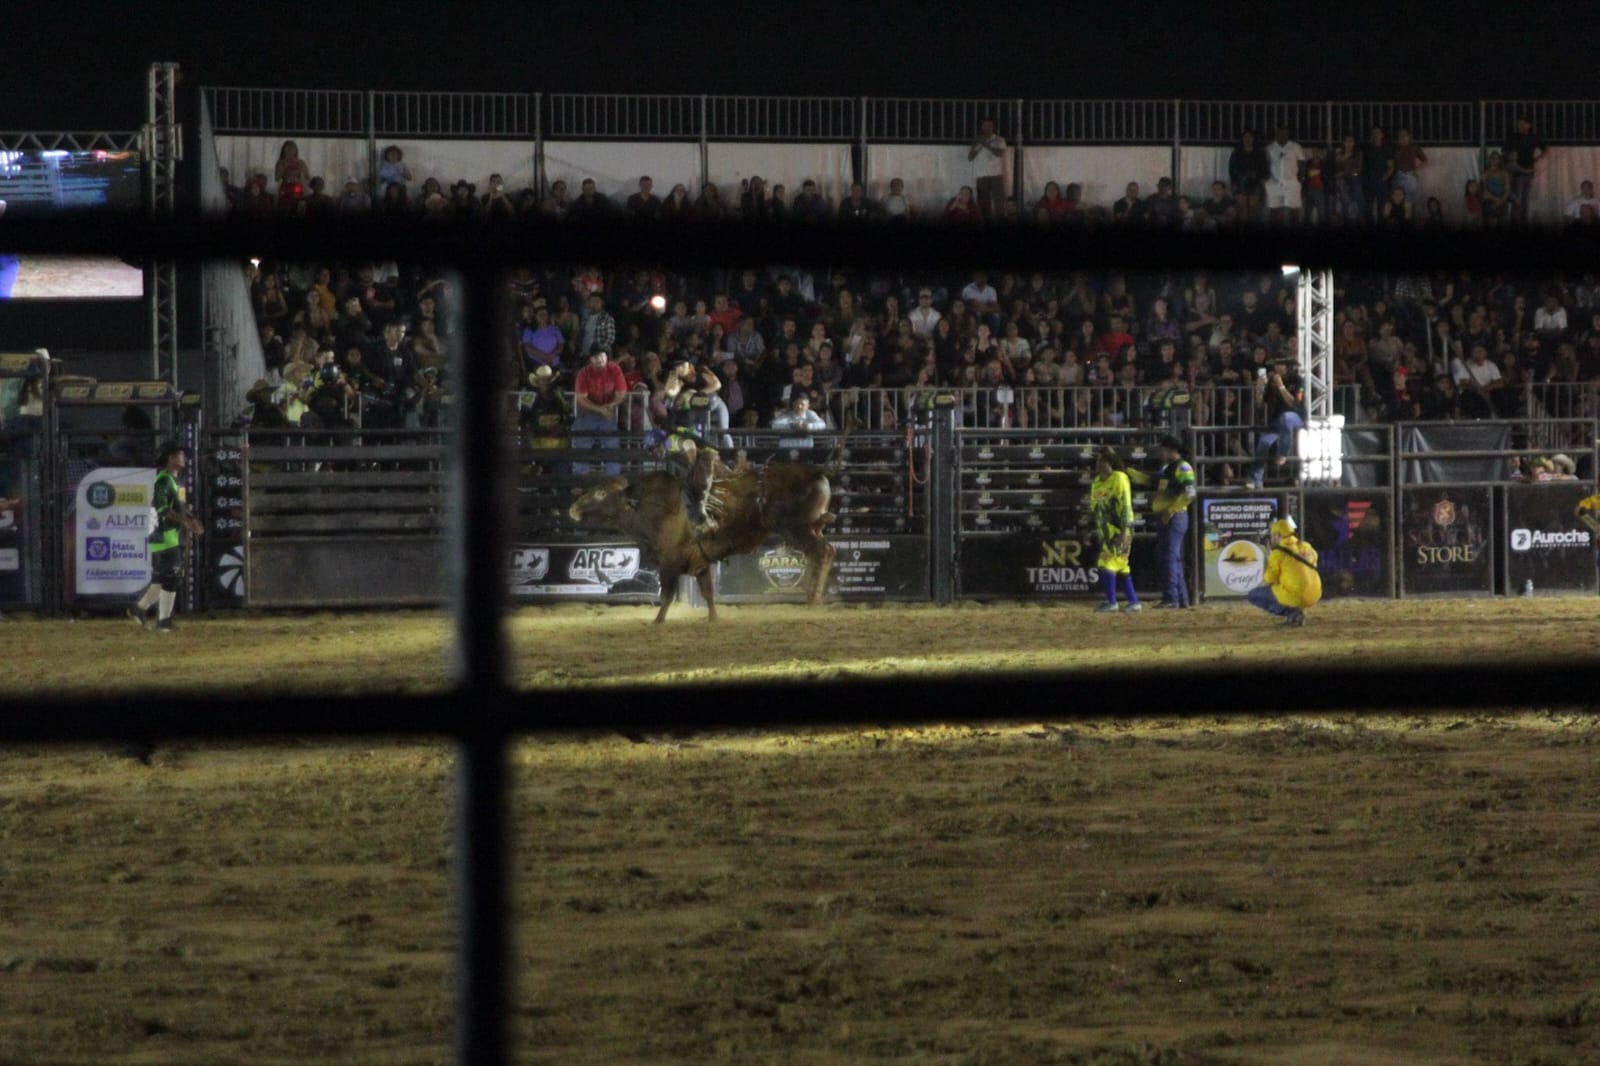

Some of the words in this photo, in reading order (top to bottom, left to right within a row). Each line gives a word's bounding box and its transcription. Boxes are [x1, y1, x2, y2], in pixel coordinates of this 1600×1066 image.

[105, 514, 148, 526] ALMT
[1532, 528, 1590, 543] Aurochs
[112, 543, 135, 551] Mato
[1417, 545, 1473, 564] STORE
[112, 551, 144, 559] Grosso
[573, 550, 616, 569] ARC
[1025, 567, 1100, 583] TENDAS
